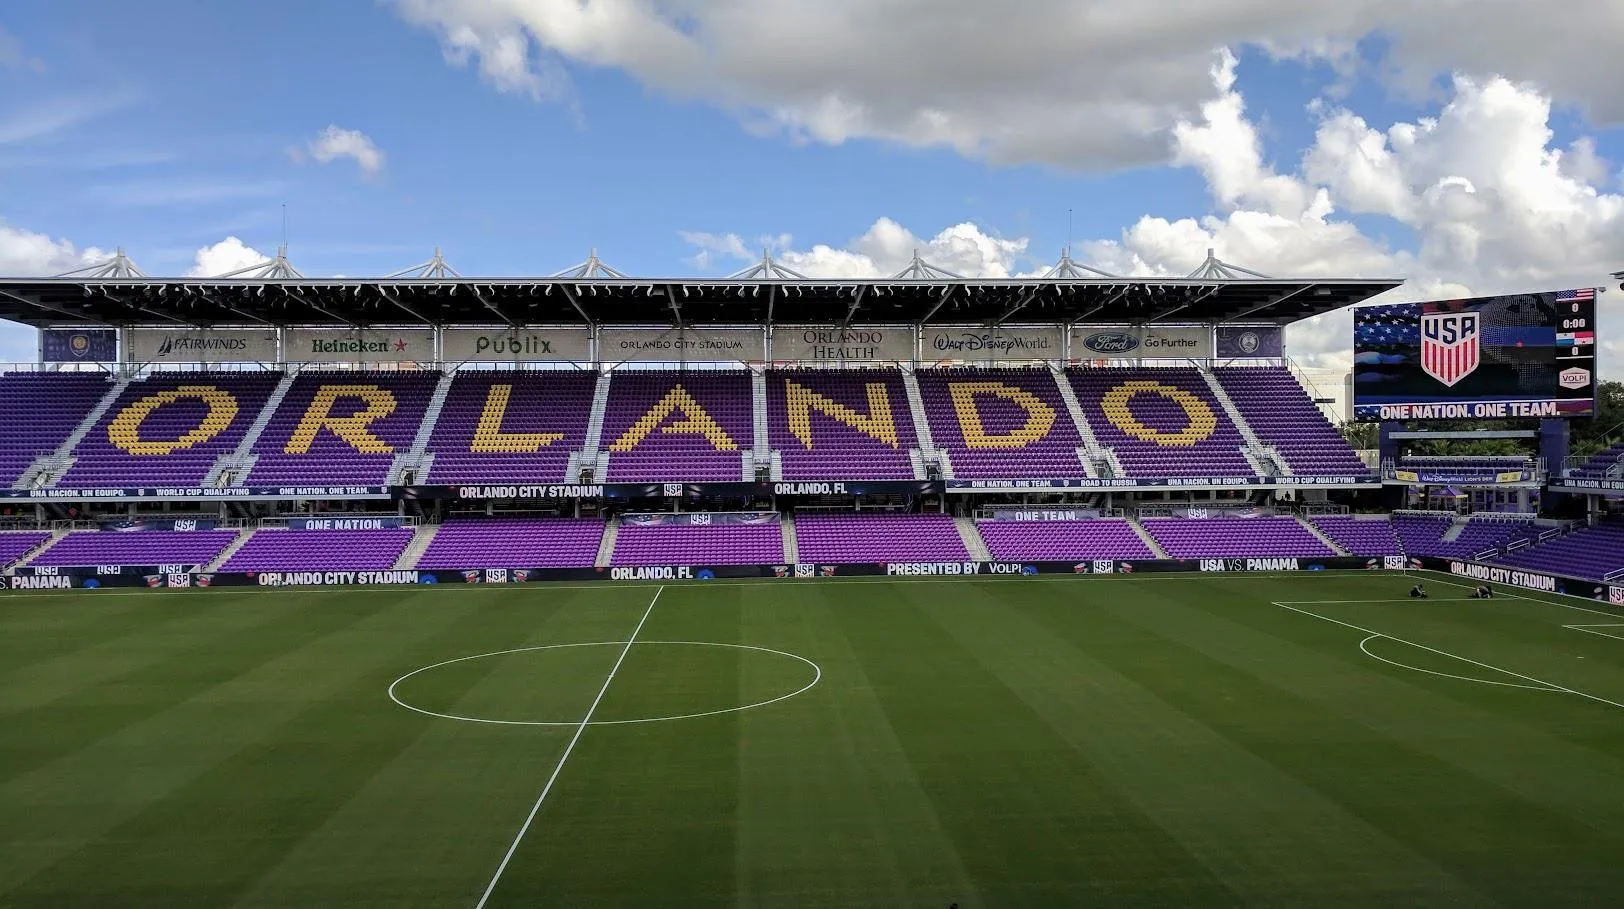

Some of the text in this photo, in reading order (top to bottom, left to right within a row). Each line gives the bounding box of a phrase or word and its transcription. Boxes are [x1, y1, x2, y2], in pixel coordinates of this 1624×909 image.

[1571, 303, 1579, 312] 0
[1563, 318, 1586, 329] 0:00
[1424, 316, 1476, 344] USA
[803, 330, 882, 344] ORLANDO
[1093, 334, 1129, 352] Ford
[1144, 338, 1197, 348] Go Further
[174, 338, 247, 351] FAIRWINDS
[312, 339, 389, 353] Heineken
[476, 336, 552, 354] Publix
[620, 341, 743, 349] ORLANDO CITY STADIUM
[813, 345, 874, 359] HEALTH
[1571, 346, 1579, 356] 0
[1380, 400, 1561, 420] ONE NATION. ONE TEAM.
[971, 480, 987, 488] ONE
[988, 480, 1015, 488] NATION.
[1081, 479, 1137, 487] ROAD TO RUSSIA
[1167, 478, 1183, 486] UNA
[1212, 478, 1221, 486] UN
[1223, 478, 1249, 486] EQUIPO.
[1275, 477, 1356, 485] WORLD CUP QUALIFYING
[1564, 479, 1576, 487] UNA
[30, 489, 47, 497] UNA
[82, 489, 93, 497] UN
[95, 489, 127, 497] EQUIPO.
[156, 487, 250, 496] WORLD CUP QUALIFYING
[279, 486, 370, 495] ONE NATION. ONE TEAM.
[459, 486, 603, 499] ORLANDO CITY STADIUM
[774, 483, 848, 495] ORLANDO, FL
[1015, 511, 1078, 521] ONE TEAM.
[306, 519, 385, 530] ONE NATION.
[887, 562, 1022, 576] PRESENTED BY VOLPI
[1200, 558, 1299, 572] USA VS. PANAMA
[259, 571, 418, 586] ORLANDO CITY STADIUM
[611, 567, 693, 580] ORLANDO, FL
[1451, 561, 1556, 591] ORLANDO CITY STADIUM
[11, 576, 71, 589] PANAMA
